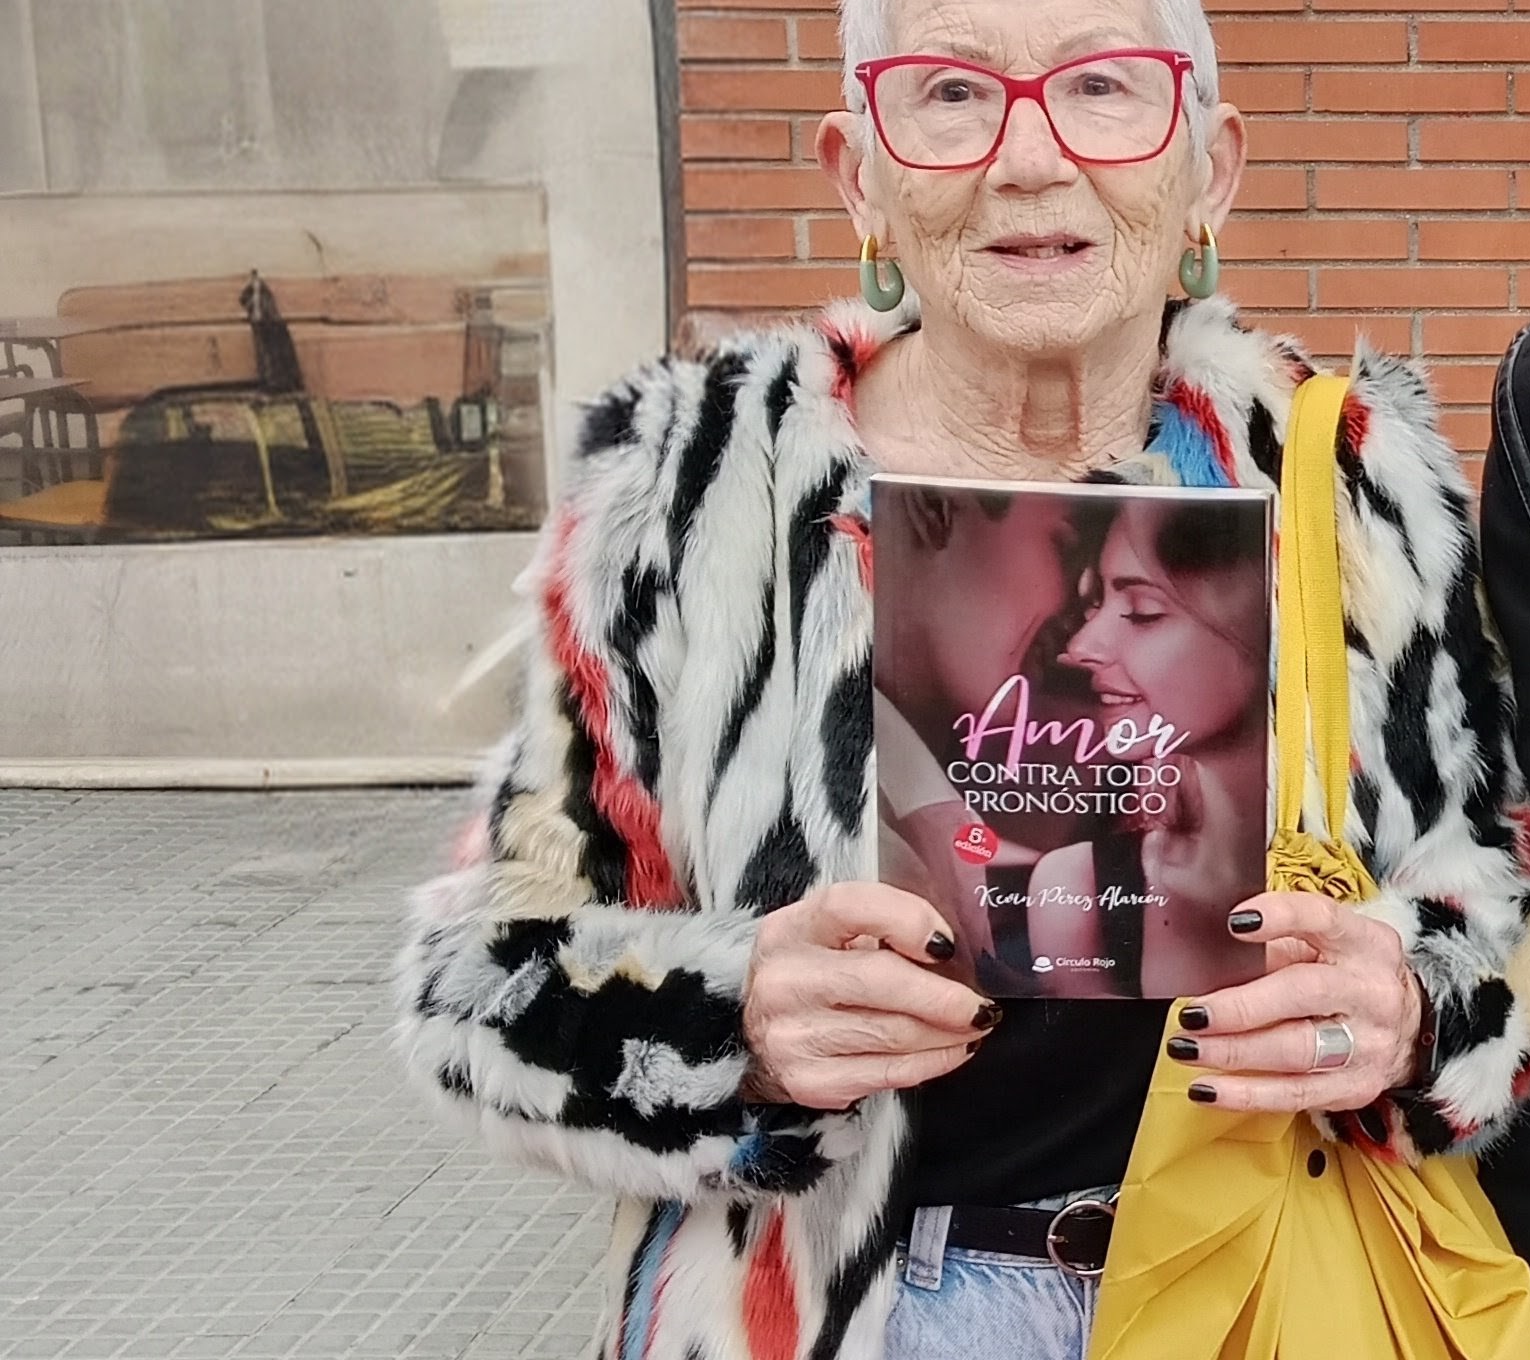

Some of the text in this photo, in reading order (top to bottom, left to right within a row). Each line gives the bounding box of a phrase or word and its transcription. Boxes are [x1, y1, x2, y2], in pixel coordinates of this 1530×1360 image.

[953, 675, 1191, 780] Amor
[947, 761, 1182, 787] CONTRA TODO
[964, 787, 1167, 815] PRONÓSTICO
[974, 885, 1036, 908] Kevin
[1094, 885, 1171, 911] Alarcón
[1092, 957, 1116, 970] Rojo
